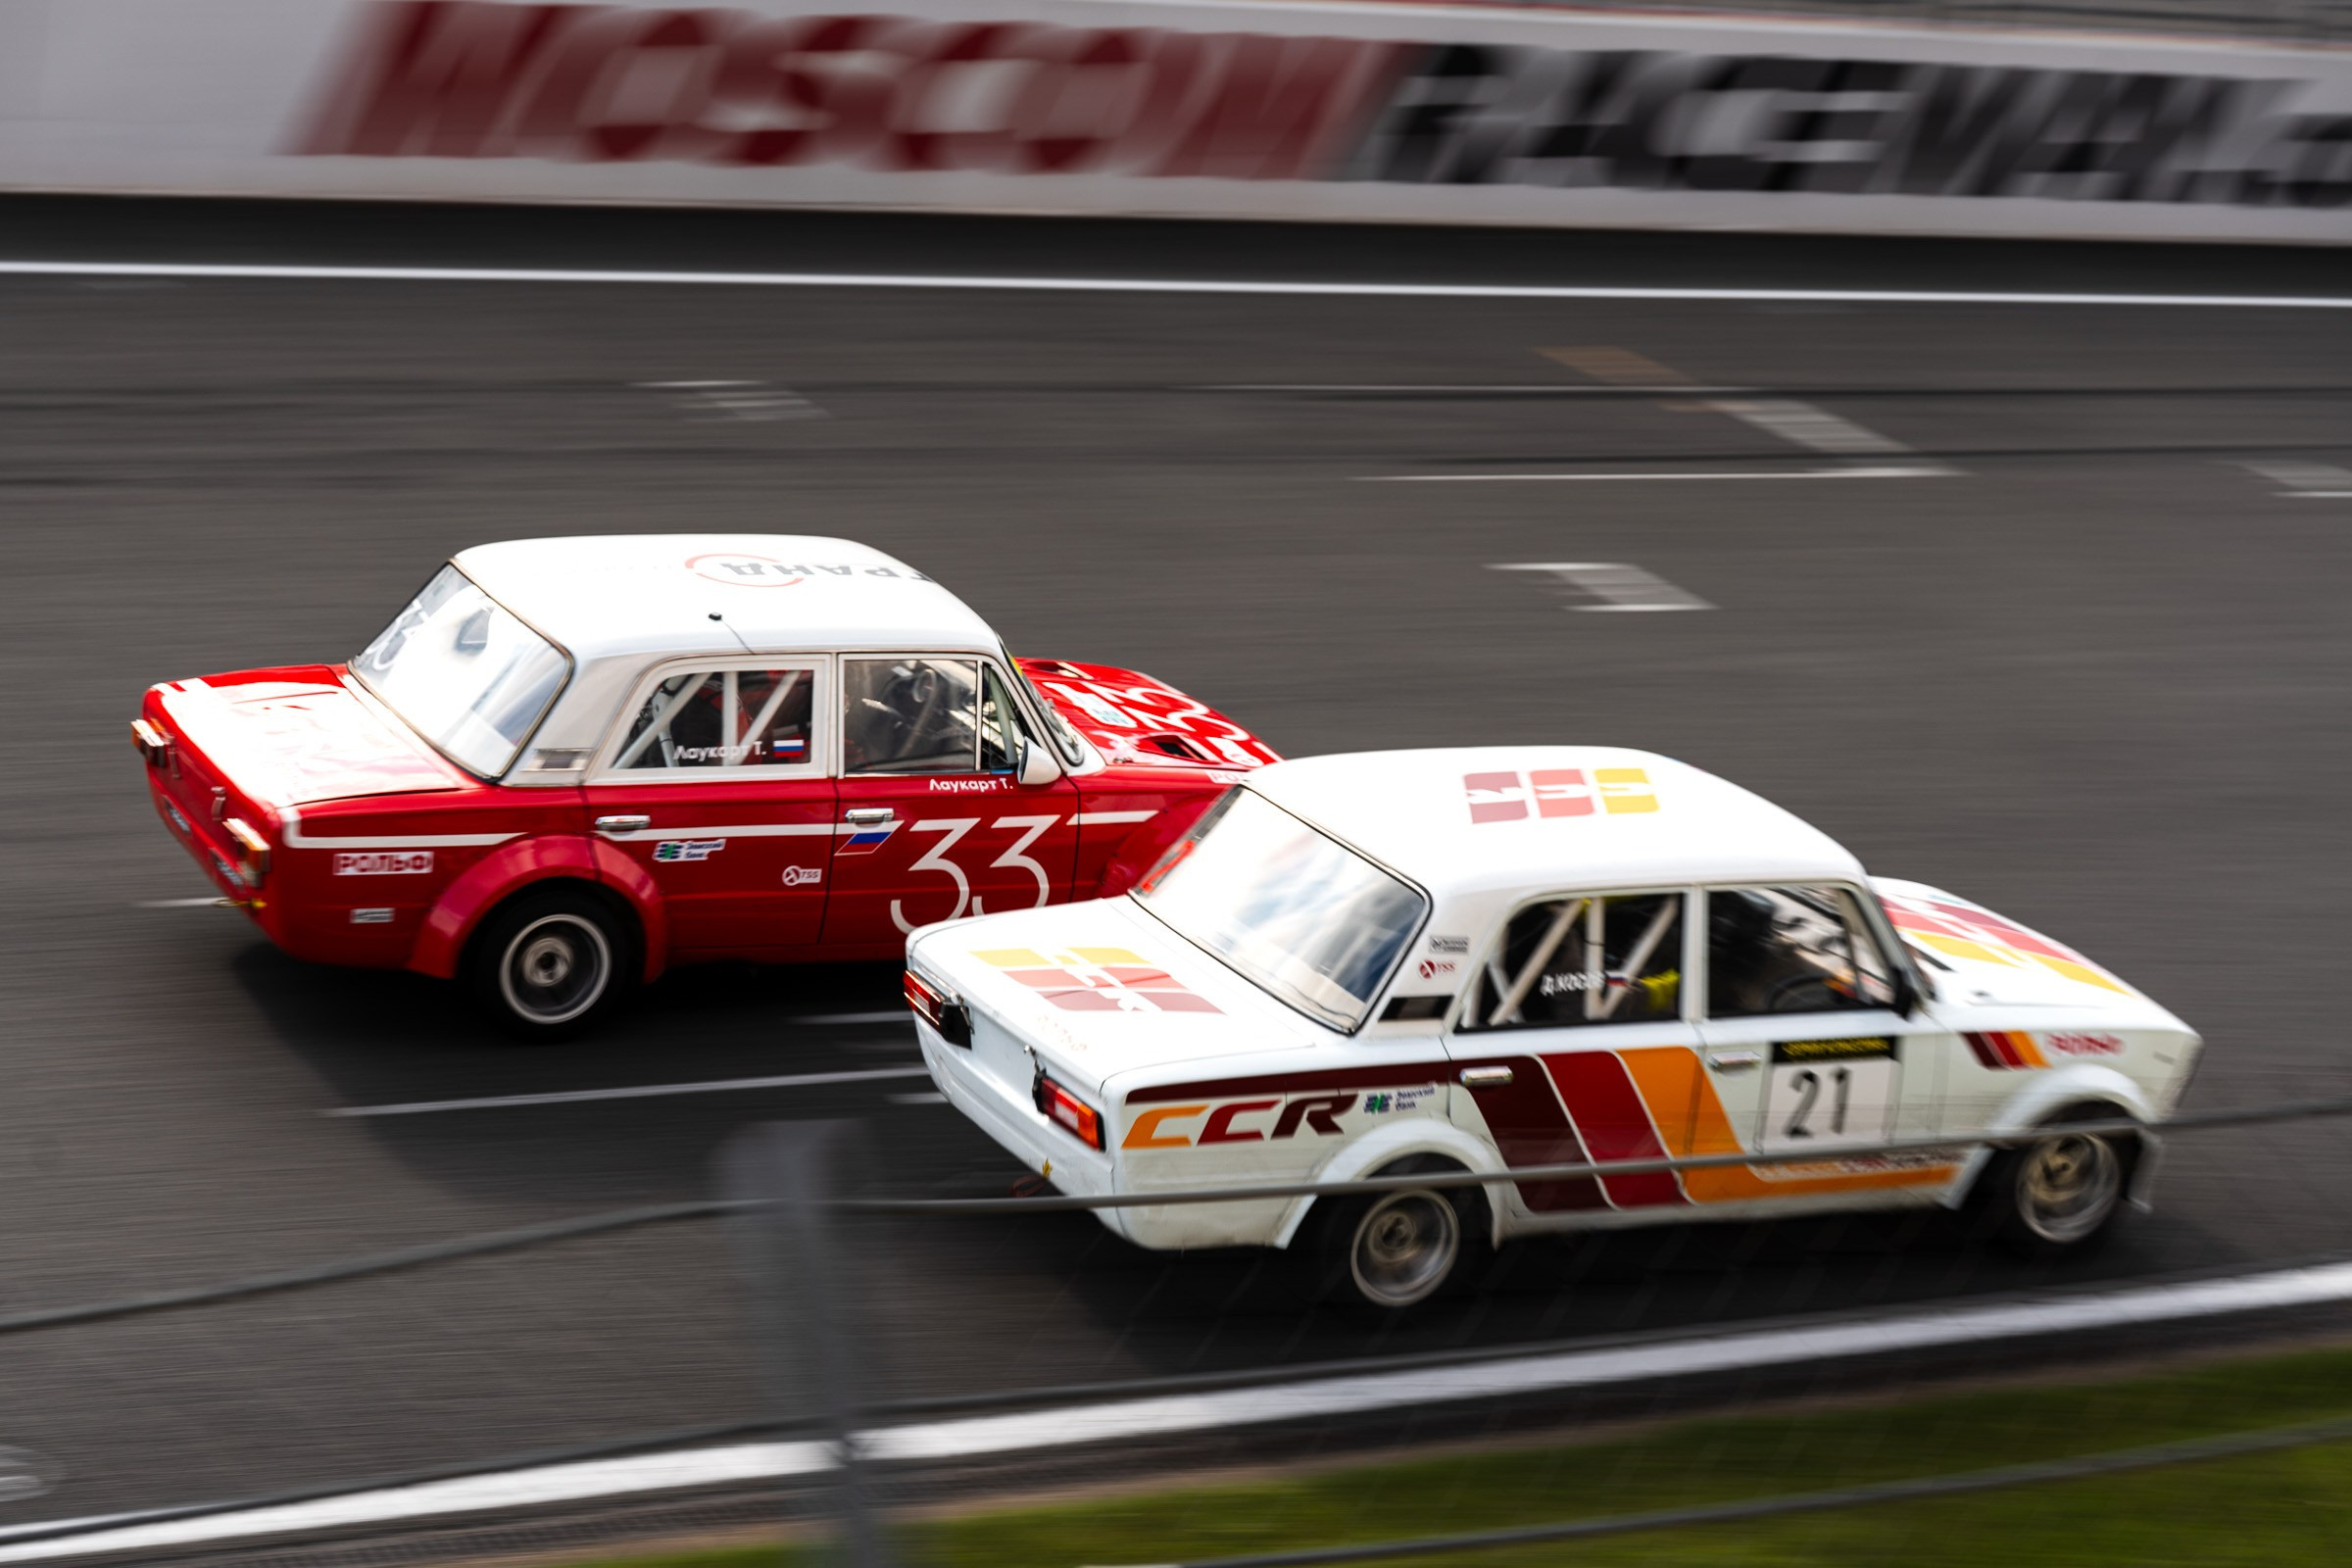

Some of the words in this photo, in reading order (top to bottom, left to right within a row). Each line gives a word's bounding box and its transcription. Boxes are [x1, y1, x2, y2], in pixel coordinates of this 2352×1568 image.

[929, 779, 997, 793] Лаукарт
[801, 870, 818, 879] TSS
[890, 814, 1060, 935] 33
[1120, 1094, 1358, 1149] CCR
[1784, 1068, 1851, 1138] 21
